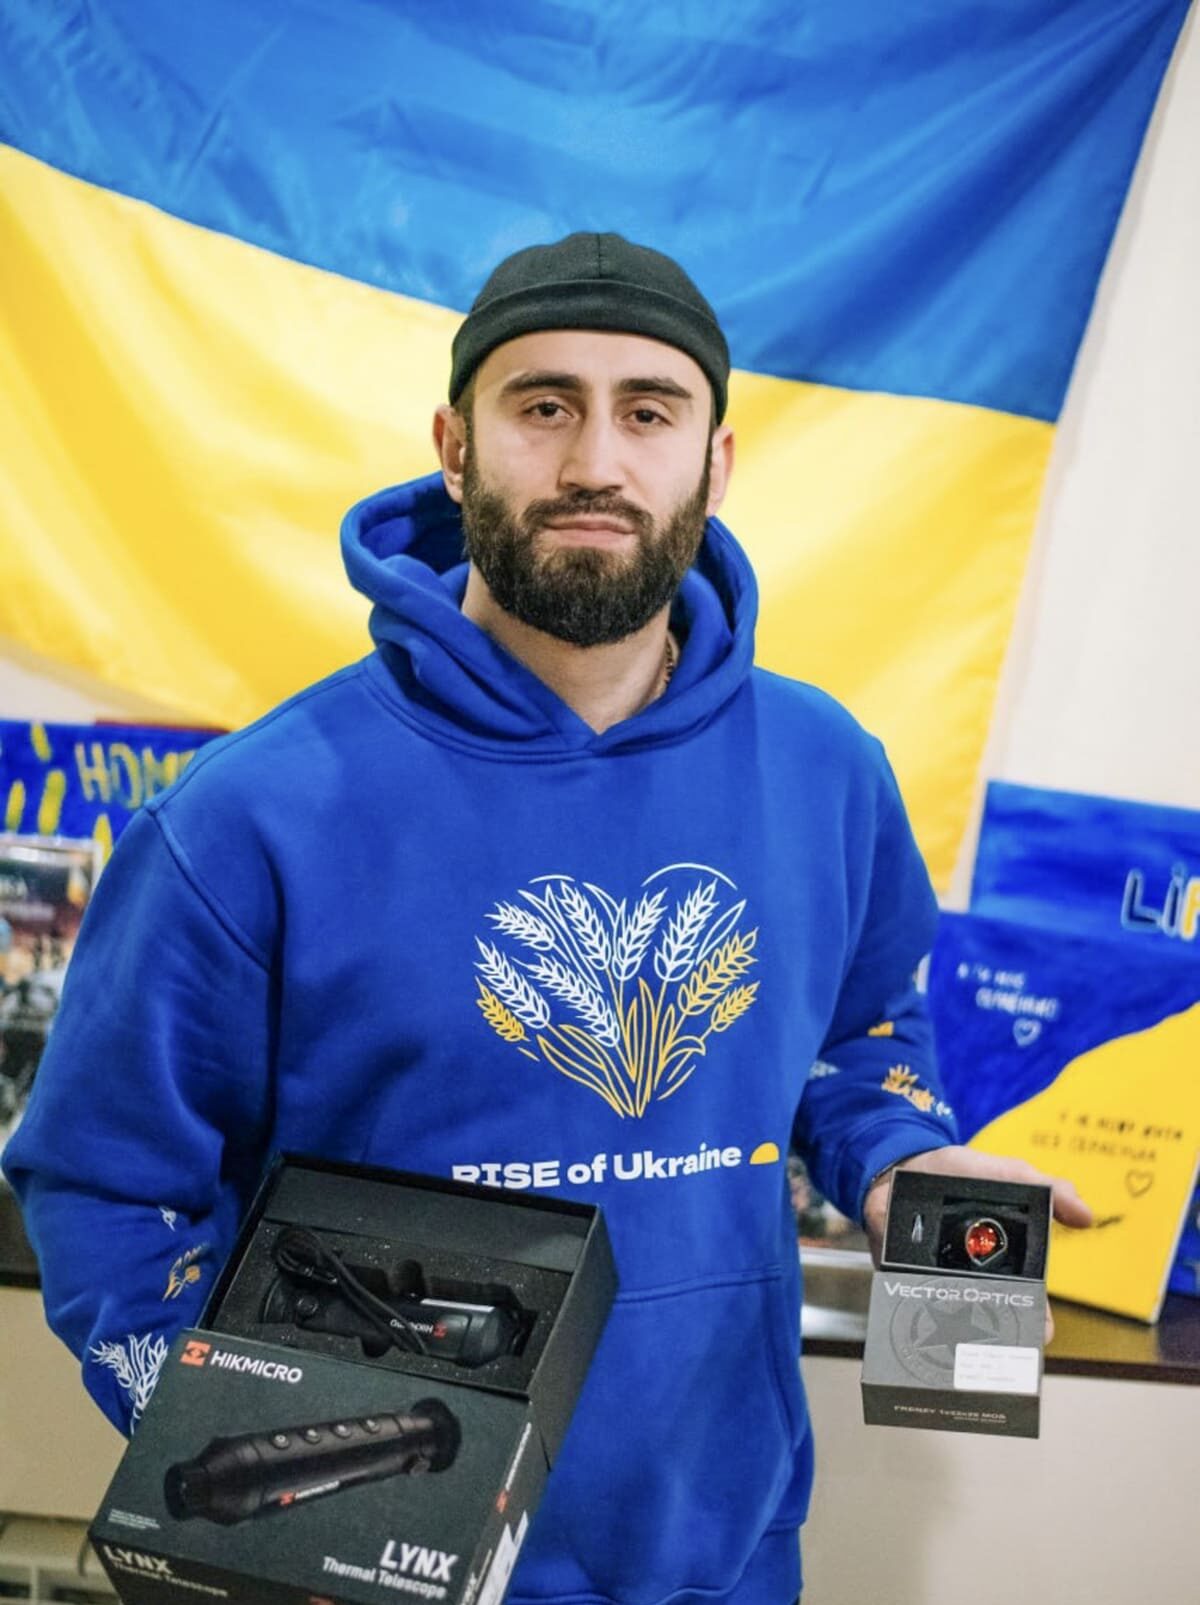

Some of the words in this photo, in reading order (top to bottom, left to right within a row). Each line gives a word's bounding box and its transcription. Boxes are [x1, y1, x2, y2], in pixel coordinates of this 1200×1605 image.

[452, 1160, 561, 1190] RISE
[567, 1153, 608, 1185] of
[613, 1142, 742, 1181] Ukraine
[210, 1350, 303, 1384] HIKMICRO
[103, 1544, 174, 1576] LYNX
[322, 1556, 377, 1583] Thermal
[378, 1569, 447, 1600] Telescope
[380, 1539, 459, 1582] LYNX
